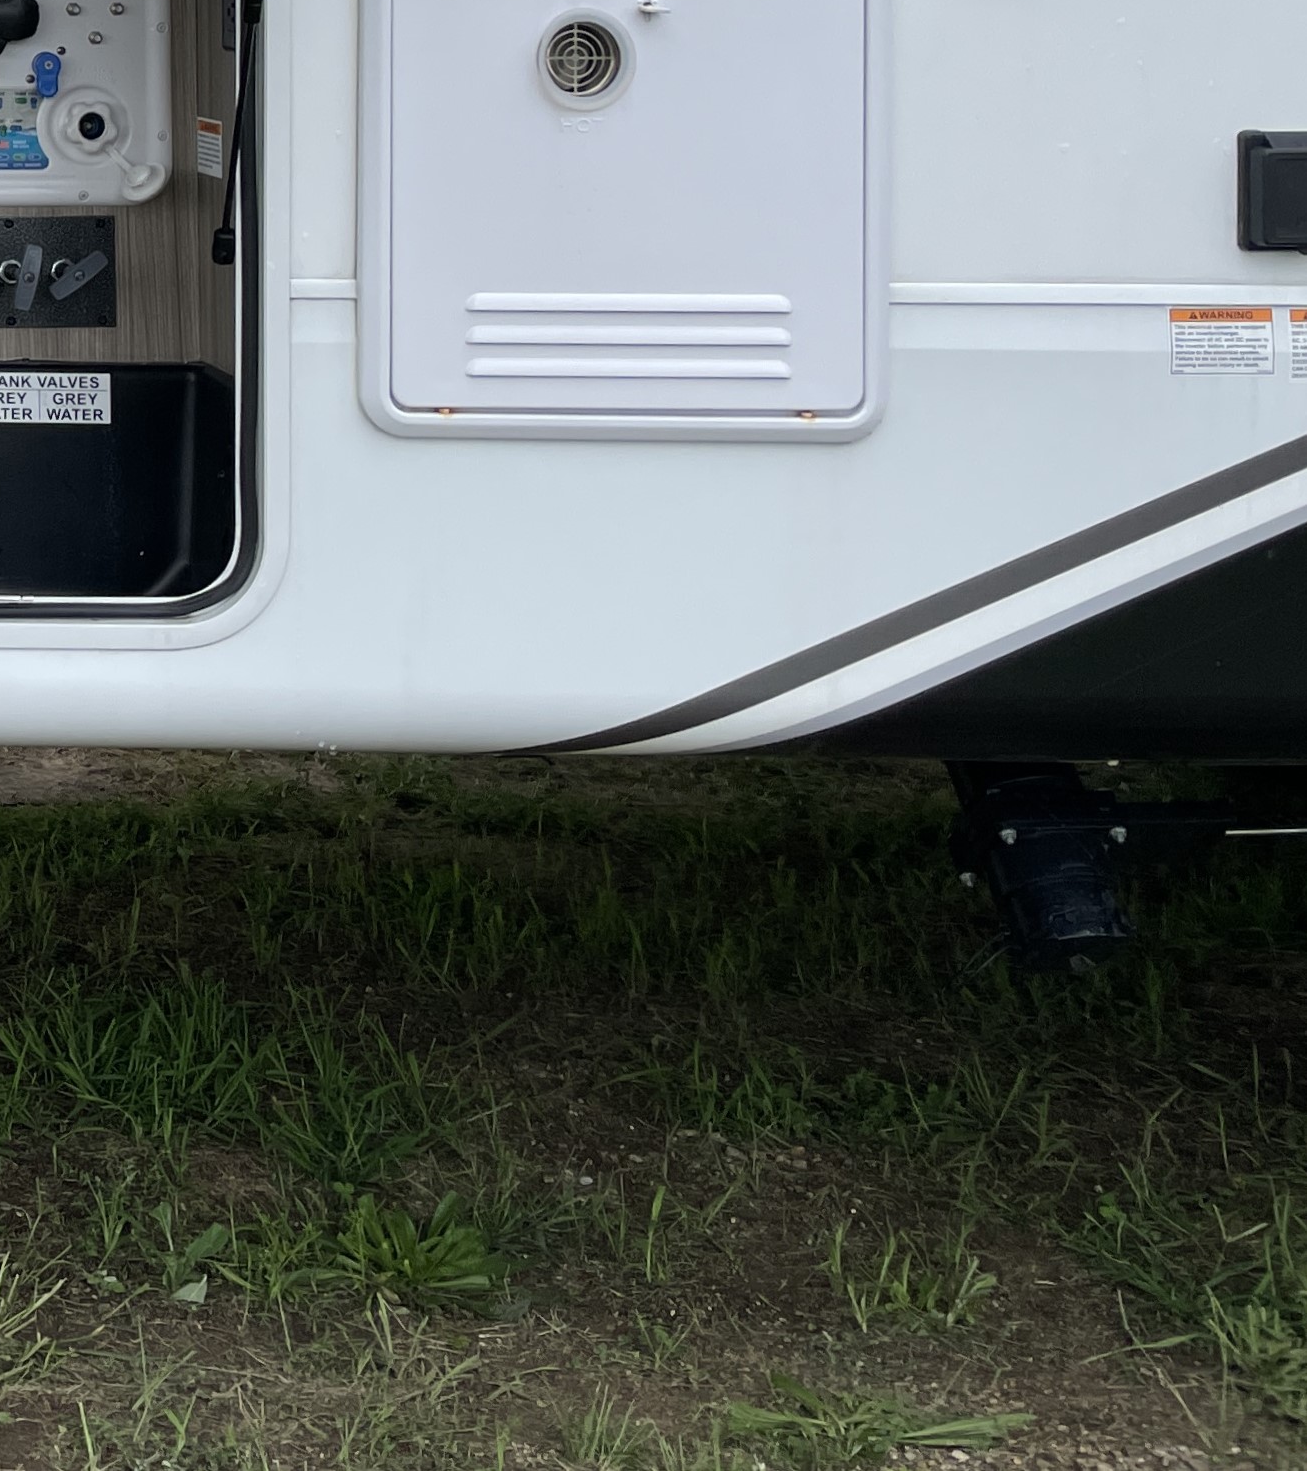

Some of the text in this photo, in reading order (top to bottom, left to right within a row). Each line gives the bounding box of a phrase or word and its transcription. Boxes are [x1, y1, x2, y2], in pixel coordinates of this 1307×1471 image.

[1199, 311, 1253, 320] WARNING
[38, 376, 100, 389] VALVES
[52, 393, 98, 406] GREY
[46, 408, 104, 421] WATER
